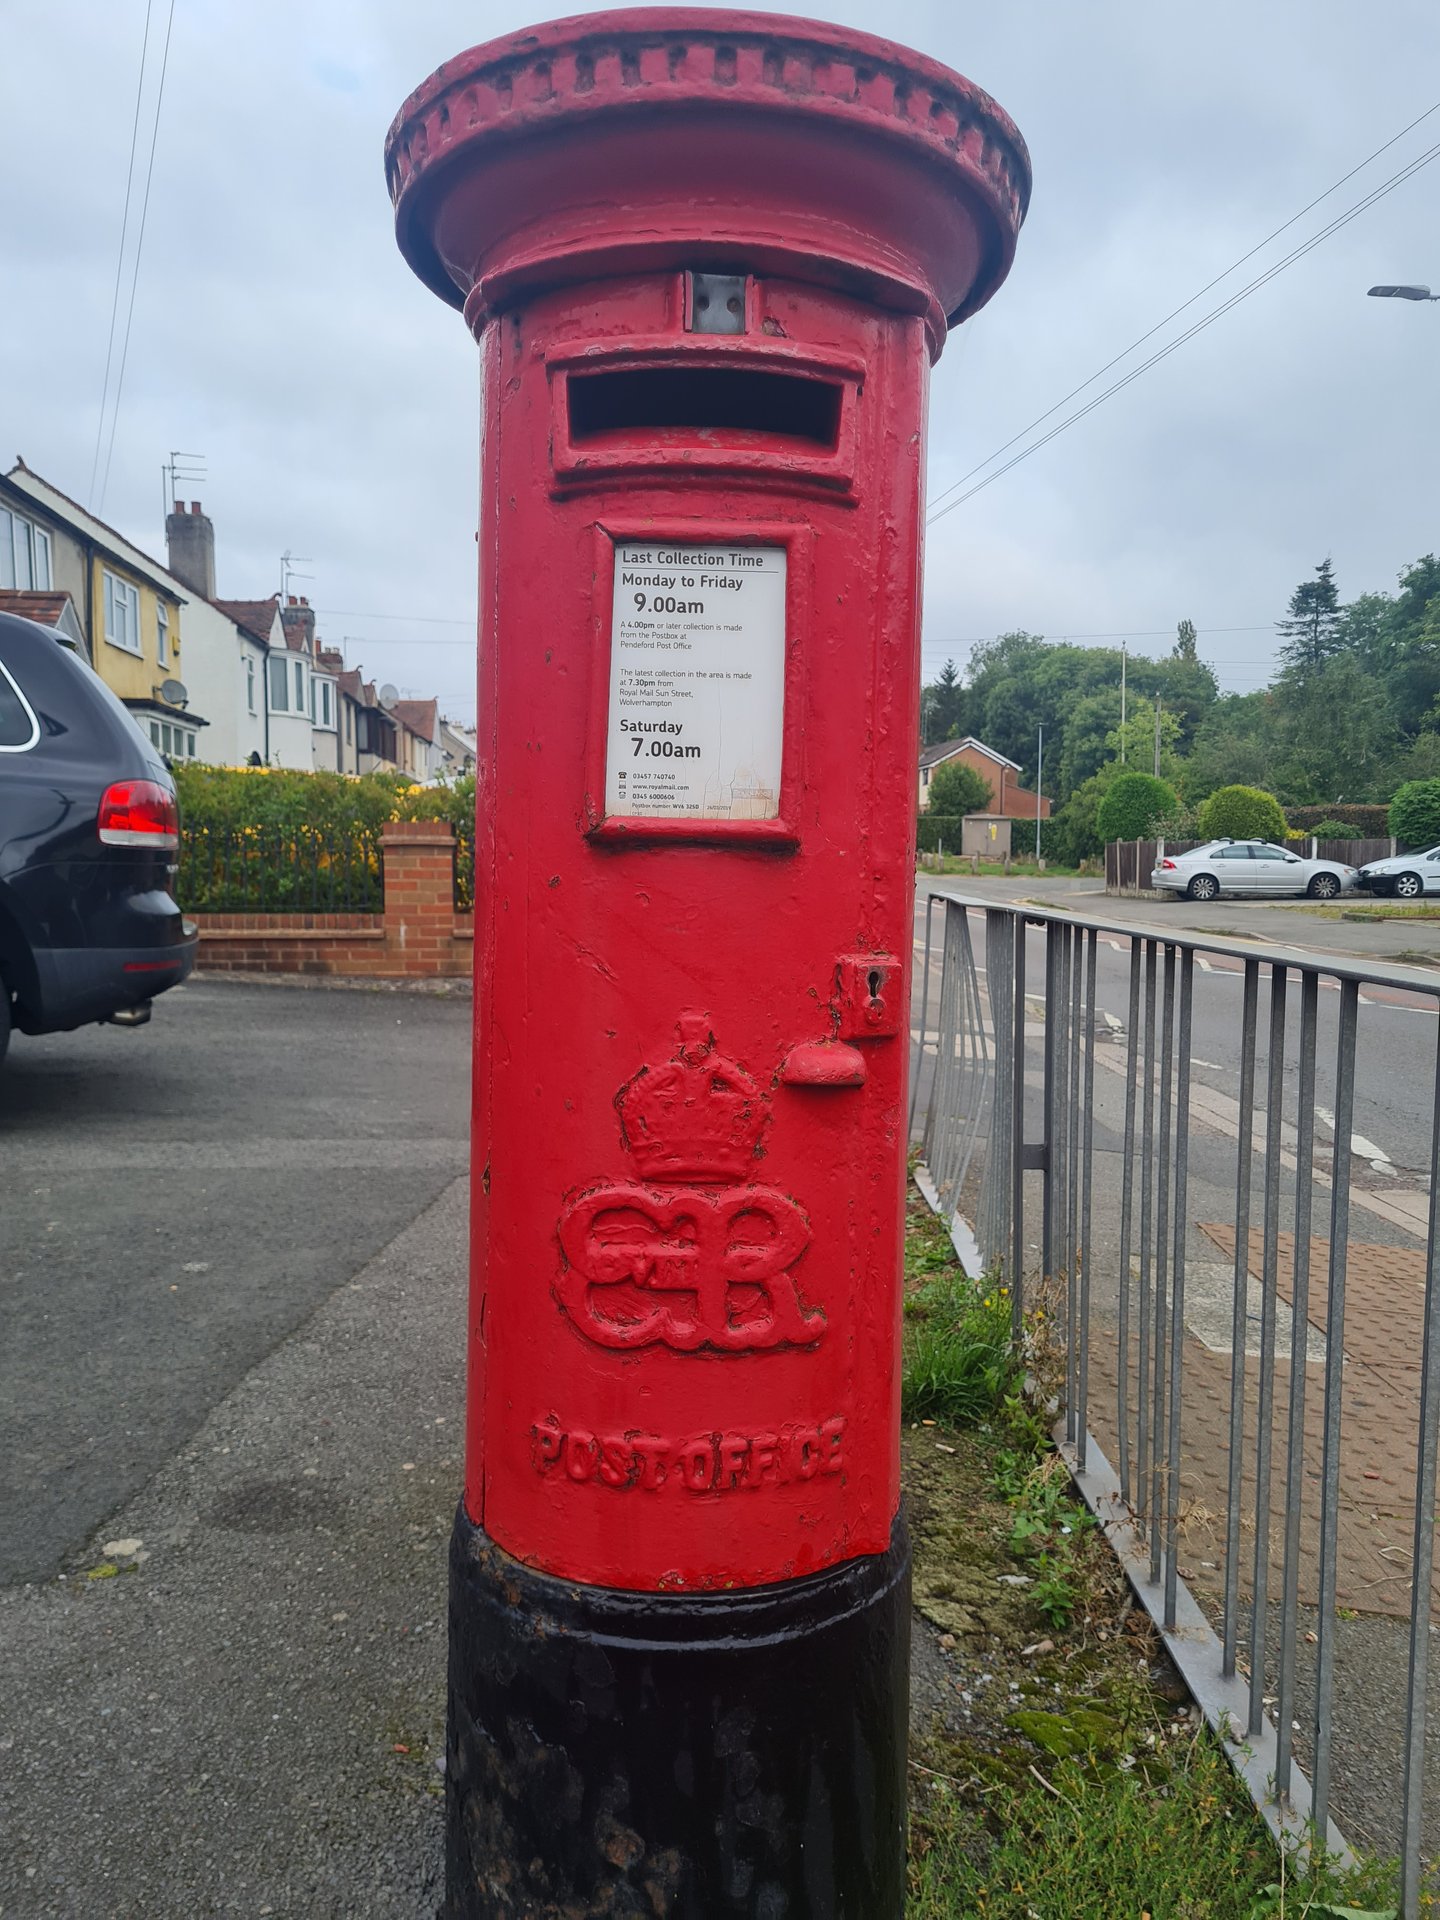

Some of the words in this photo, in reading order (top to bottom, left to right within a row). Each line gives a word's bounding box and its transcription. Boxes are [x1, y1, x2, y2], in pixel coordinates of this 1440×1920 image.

[622, 550, 652, 564] Last
[657, 551, 724, 566] Collection
[728, 553, 763, 567] Time
[622, 572, 676, 589] Monday
[681, 575, 695, 588] to
[700, 575, 743, 591] Friday
[633, 592, 704, 614] 9.00am
[627, 621, 655, 632] 4.00pm
[656, 622, 664, 630] or
[666, 622, 681, 630] later
[683, 622, 714, 631] collection
[716, 623, 722, 631] is
[723, 624, 743, 632] made
[620, 631, 637, 639] from
[638, 631, 650, 639] the
[651, 632, 679, 640] Postbox
[680, 632, 687, 640] at
[620, 641, 655, 649] Pendeford
[656, 641, 671, 650] Post
[672, 642, 692, 650] Office
[620, 669, 633, 677] The
[634, 669, 653, 678] latest
[654, 670, 686, 678] collection
[687, 670, 694, 678] in
[725, 671, 731, 679] is
[733, 672, 752, 680] made
[628, 678, 656, 689] 7.30pm
[657, 679, 674, 687] from
[619, 688, 638, 698] Royal
[639, 689, 654, 697] Mail
[656, 689, 669, 697] Sun
[671, 689, 694, 698] Street,
[619, 698, 672, 707] Wolverhampton
[620, 719, 683, 736] Saturday
[631, 737, 701, 758] 7.00am
